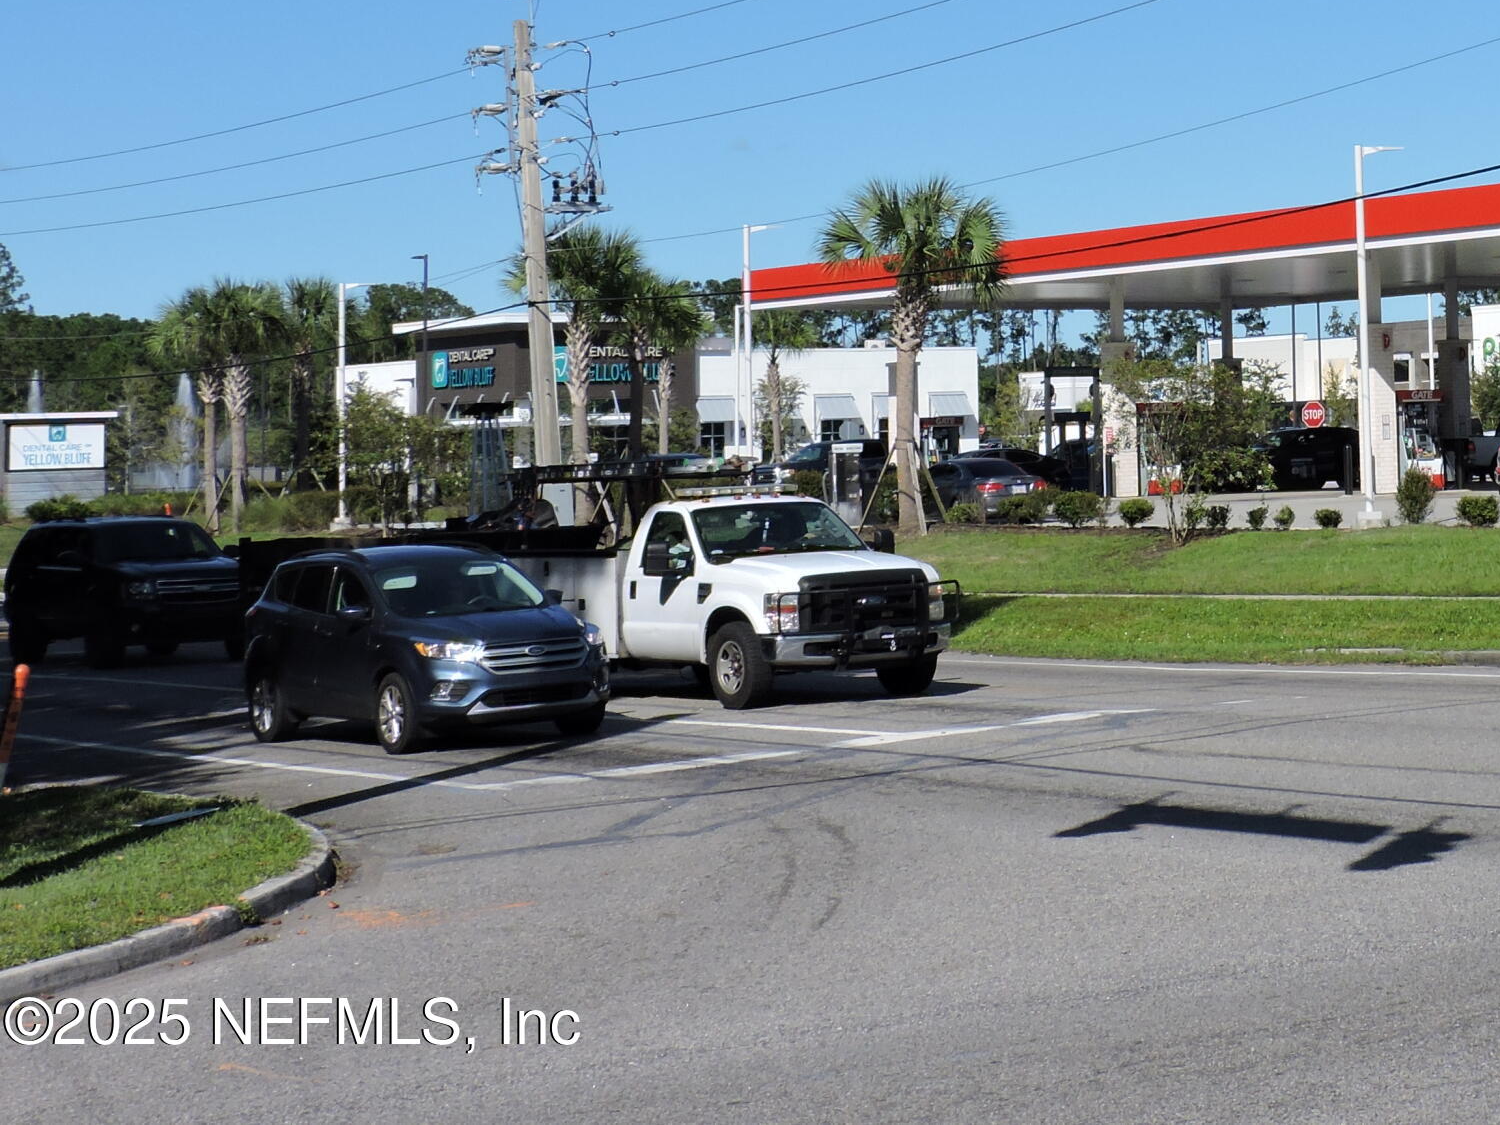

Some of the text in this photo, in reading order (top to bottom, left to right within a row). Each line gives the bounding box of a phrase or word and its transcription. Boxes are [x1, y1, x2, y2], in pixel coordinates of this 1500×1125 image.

[448, 350, 472, 363] DENTAL
[589, 346, 628, 357] ENTAL
[588, 364, 632, 382] ELLOW
[1411, 390, 1433, 399] GATE
[1303, 410, 1323, 420] STOP
[22, 444, 57, 452] DENTAL
[60, 443, 82, 451] CARE
[24, 453, 92, 465] YELLOW BLUFF
